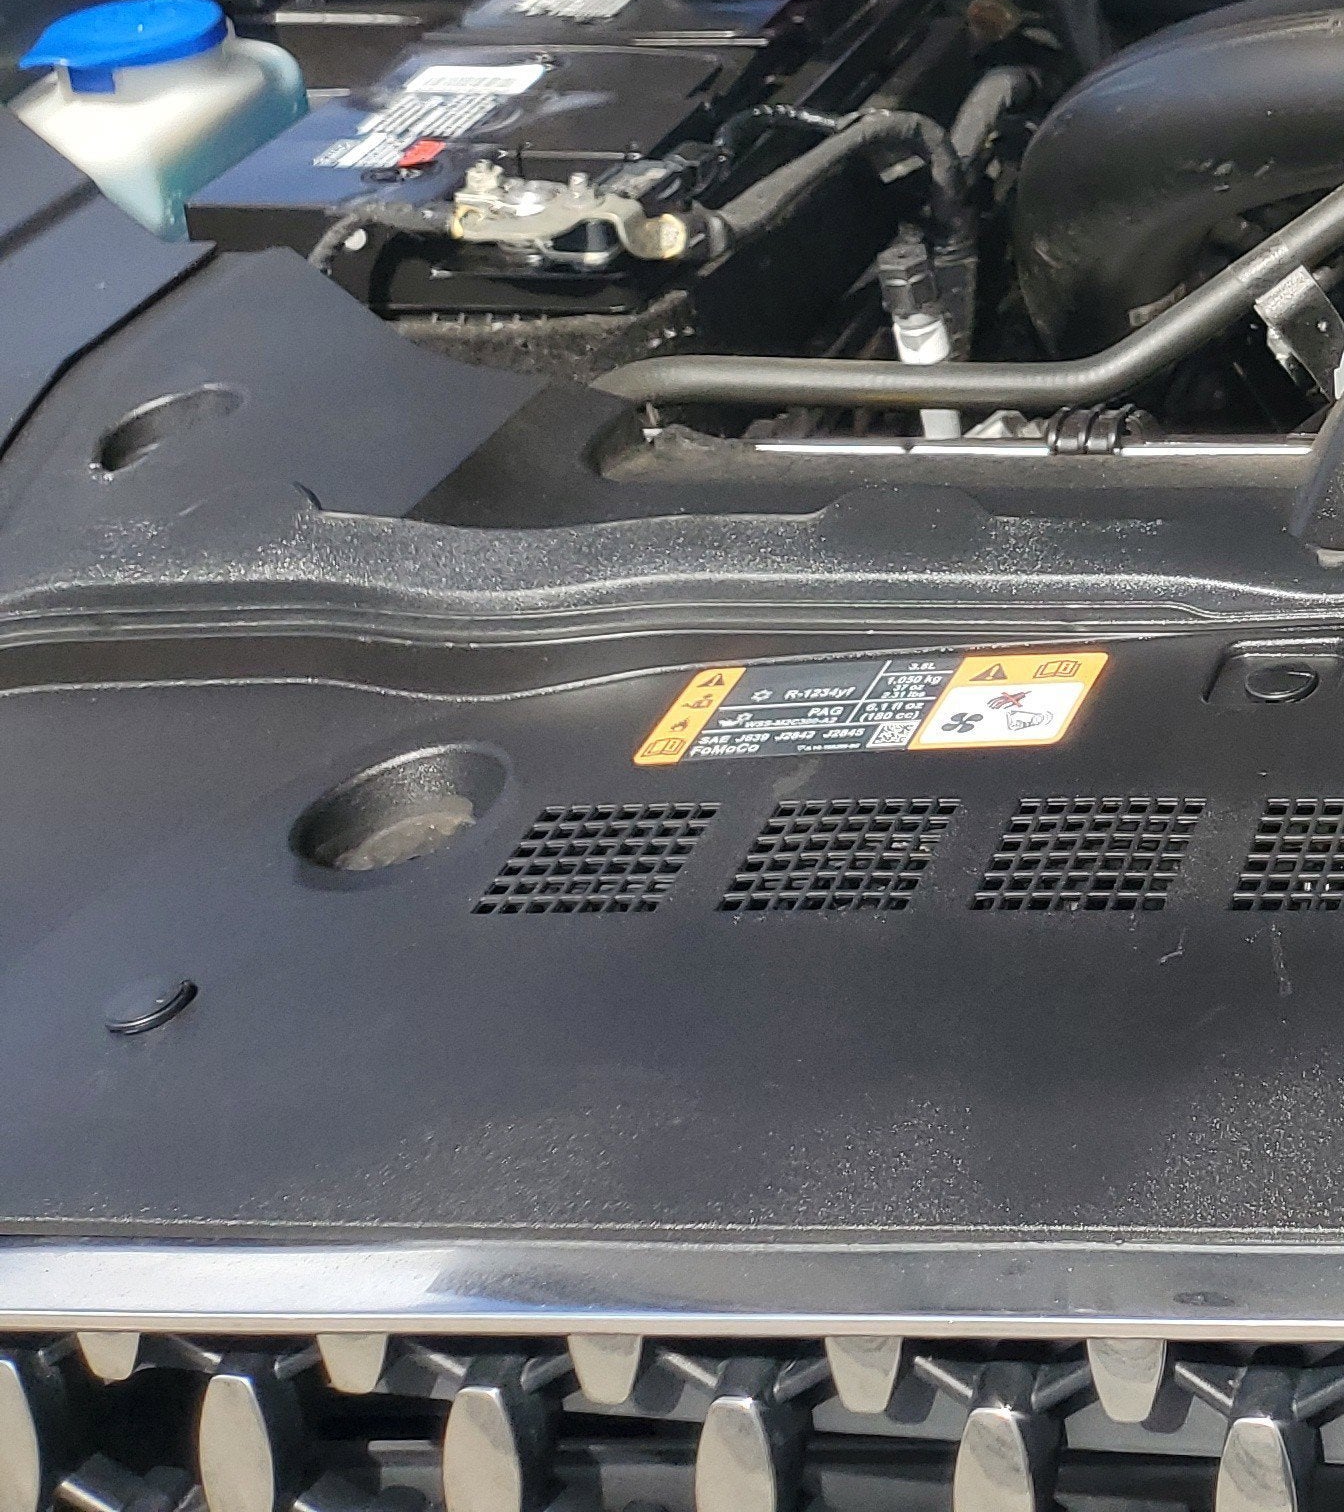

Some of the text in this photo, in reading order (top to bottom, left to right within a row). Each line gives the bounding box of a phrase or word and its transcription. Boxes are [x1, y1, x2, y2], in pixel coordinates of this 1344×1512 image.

[887, 675, 943, 685] 1.050 kg
[785, 686, 856, 700] R-1234yf
[807, 706, 844, 717] PAG
[866, 703, 887, 711] 6.1
[891, 702, 903, 710] fl
[860, 712, 920, 722] (180 cc)
[698, 736, 732, 745] SAE
[690, 743, 761, 756] FoMoCo
